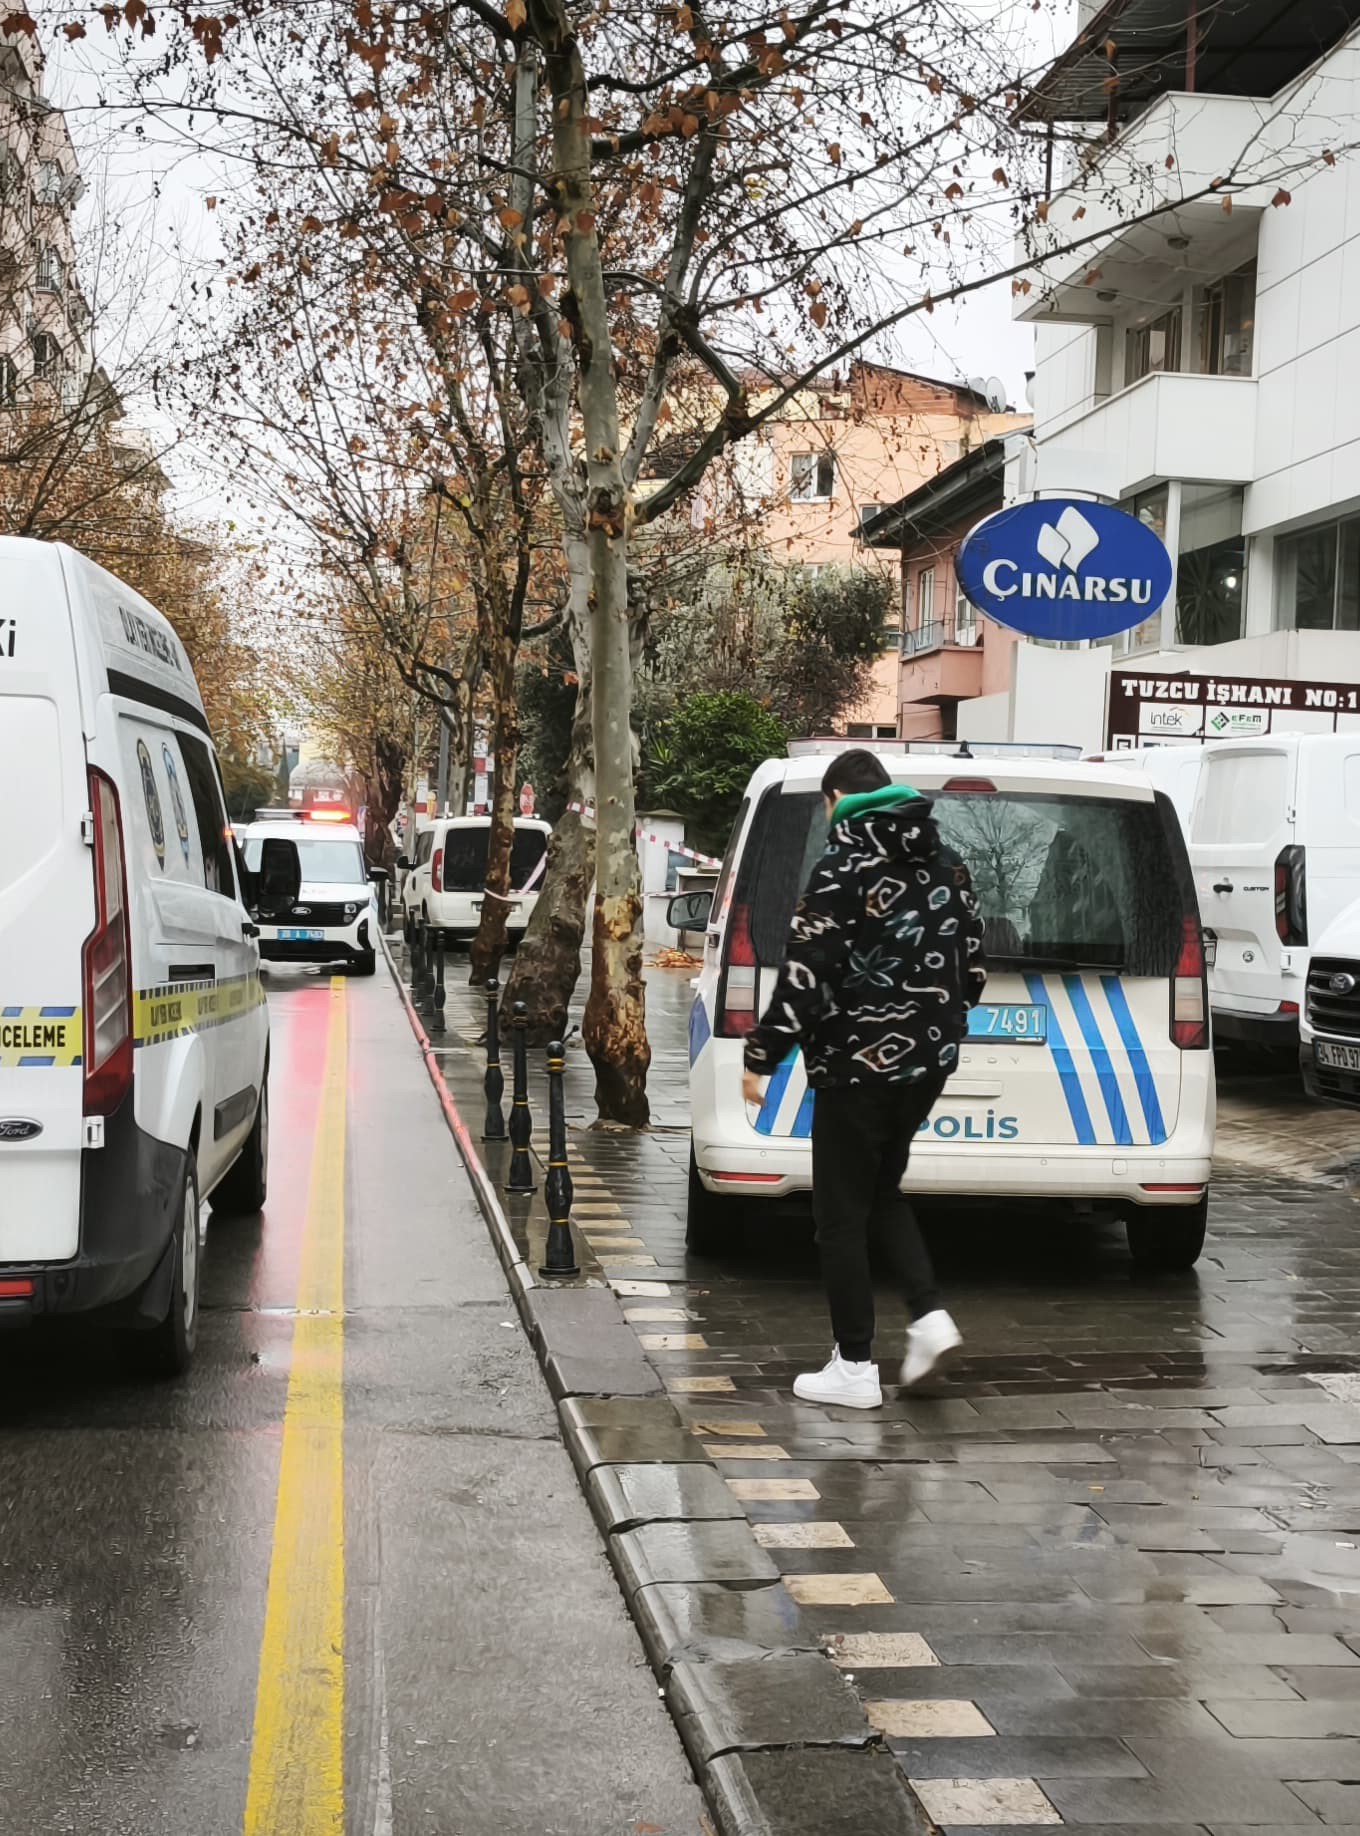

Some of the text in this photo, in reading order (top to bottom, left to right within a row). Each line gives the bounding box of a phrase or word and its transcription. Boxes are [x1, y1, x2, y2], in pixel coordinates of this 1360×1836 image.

[983, 559, 1151, 603] ÇINARSU
[1122, 679, 1199, 699] TUZCU
[1207, 680, 1292, 705] İŞHANI
[986, 1008, 1039, 1033] 7491
